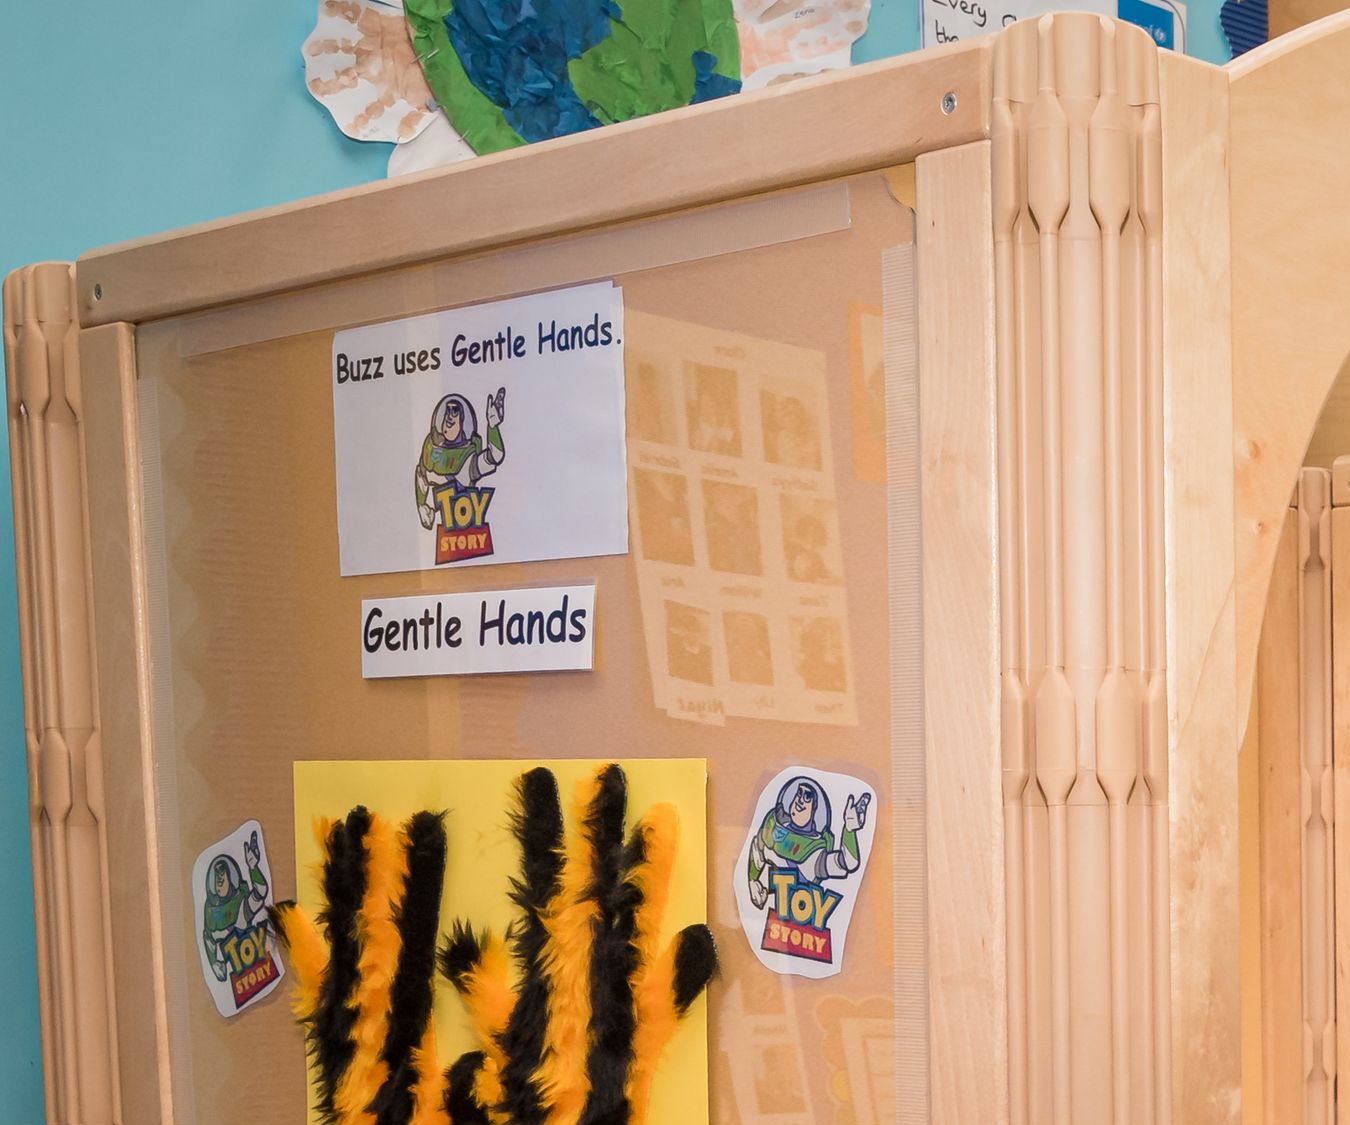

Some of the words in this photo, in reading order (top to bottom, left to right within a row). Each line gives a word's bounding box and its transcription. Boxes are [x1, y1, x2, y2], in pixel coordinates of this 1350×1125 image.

[932, 0, 987, 28] very
[336, 352, 385, 385] Buzz
[393, 346, 442, 377] uses
[450, 325, 527, 367] Gentle
[537, 312, 622, 355] Hands.
[434, 485, 492, 530] TOY
[440, 532, 488, 553] STORY
[362, 606, 463, 654] Gentle
[479, 593, 588, 648] Hands
[770, 871, 840, 931] TOY
[222, 924, 268, 974] TOY
[768, 922, 828, 954] STORY
[235, 960, 273, 995] STORY
